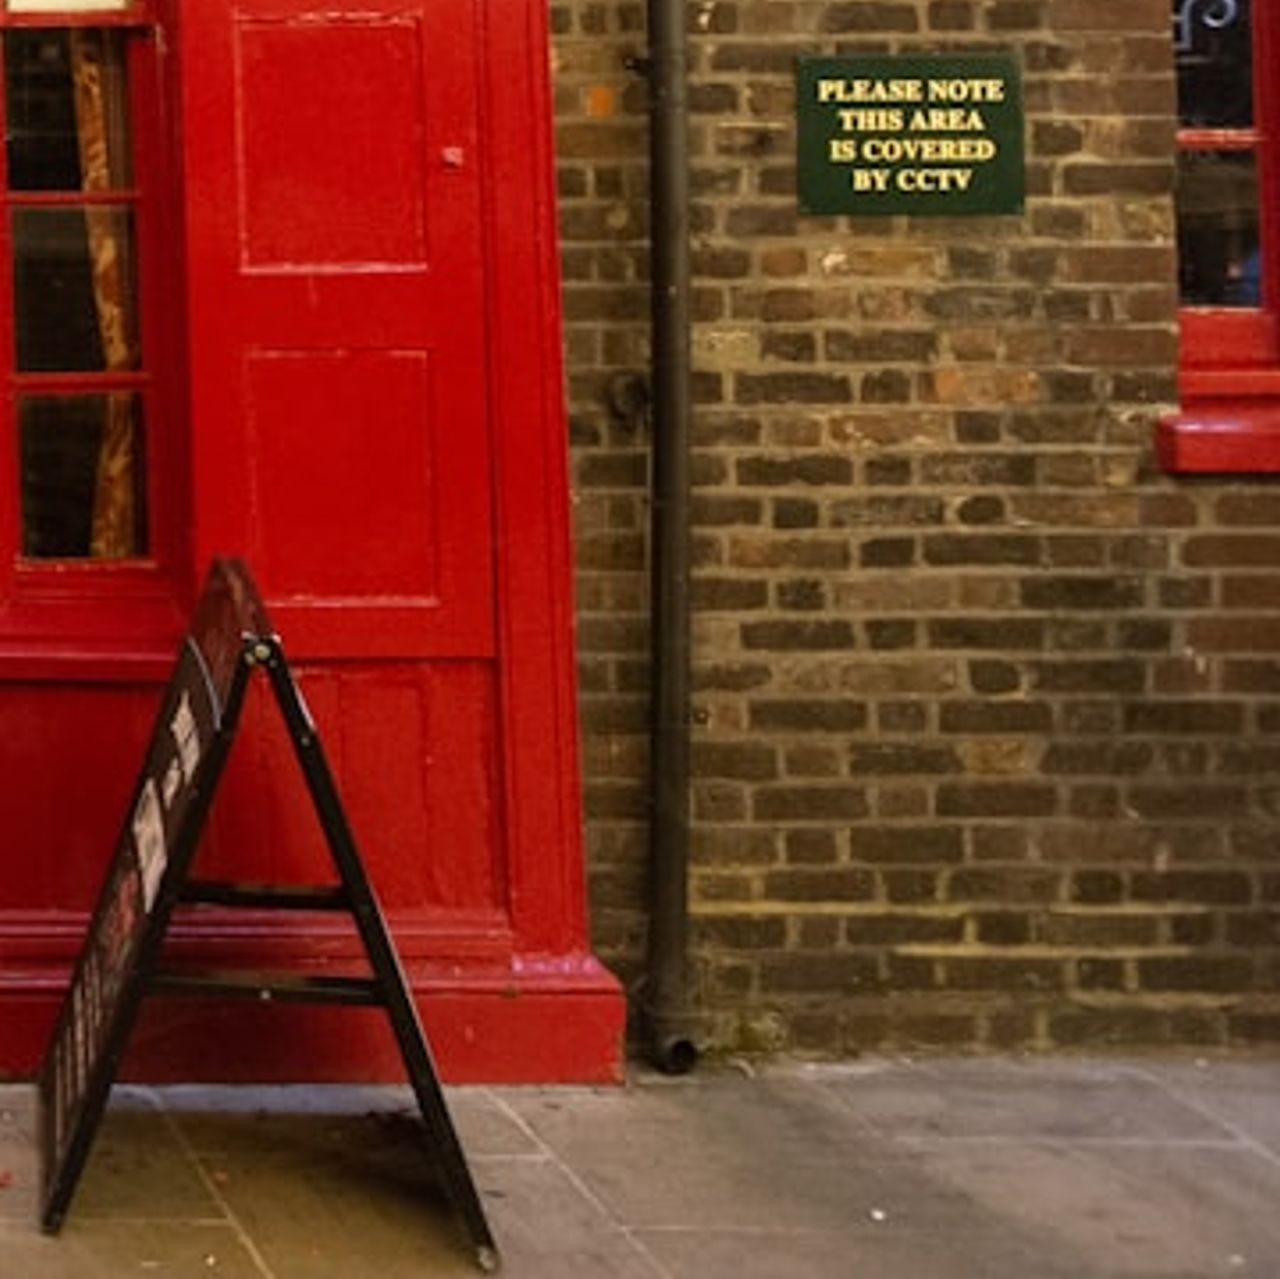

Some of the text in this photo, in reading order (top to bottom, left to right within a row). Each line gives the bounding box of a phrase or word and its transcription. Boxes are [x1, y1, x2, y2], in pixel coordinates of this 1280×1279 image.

[817, 79, 1004, 102] PLEASE NOTE
[838, 109, 985, 131] THIS AREA
[830, 139, 996, 162] IS COVERED
[853, 169, 973, 191] BY CCTV
